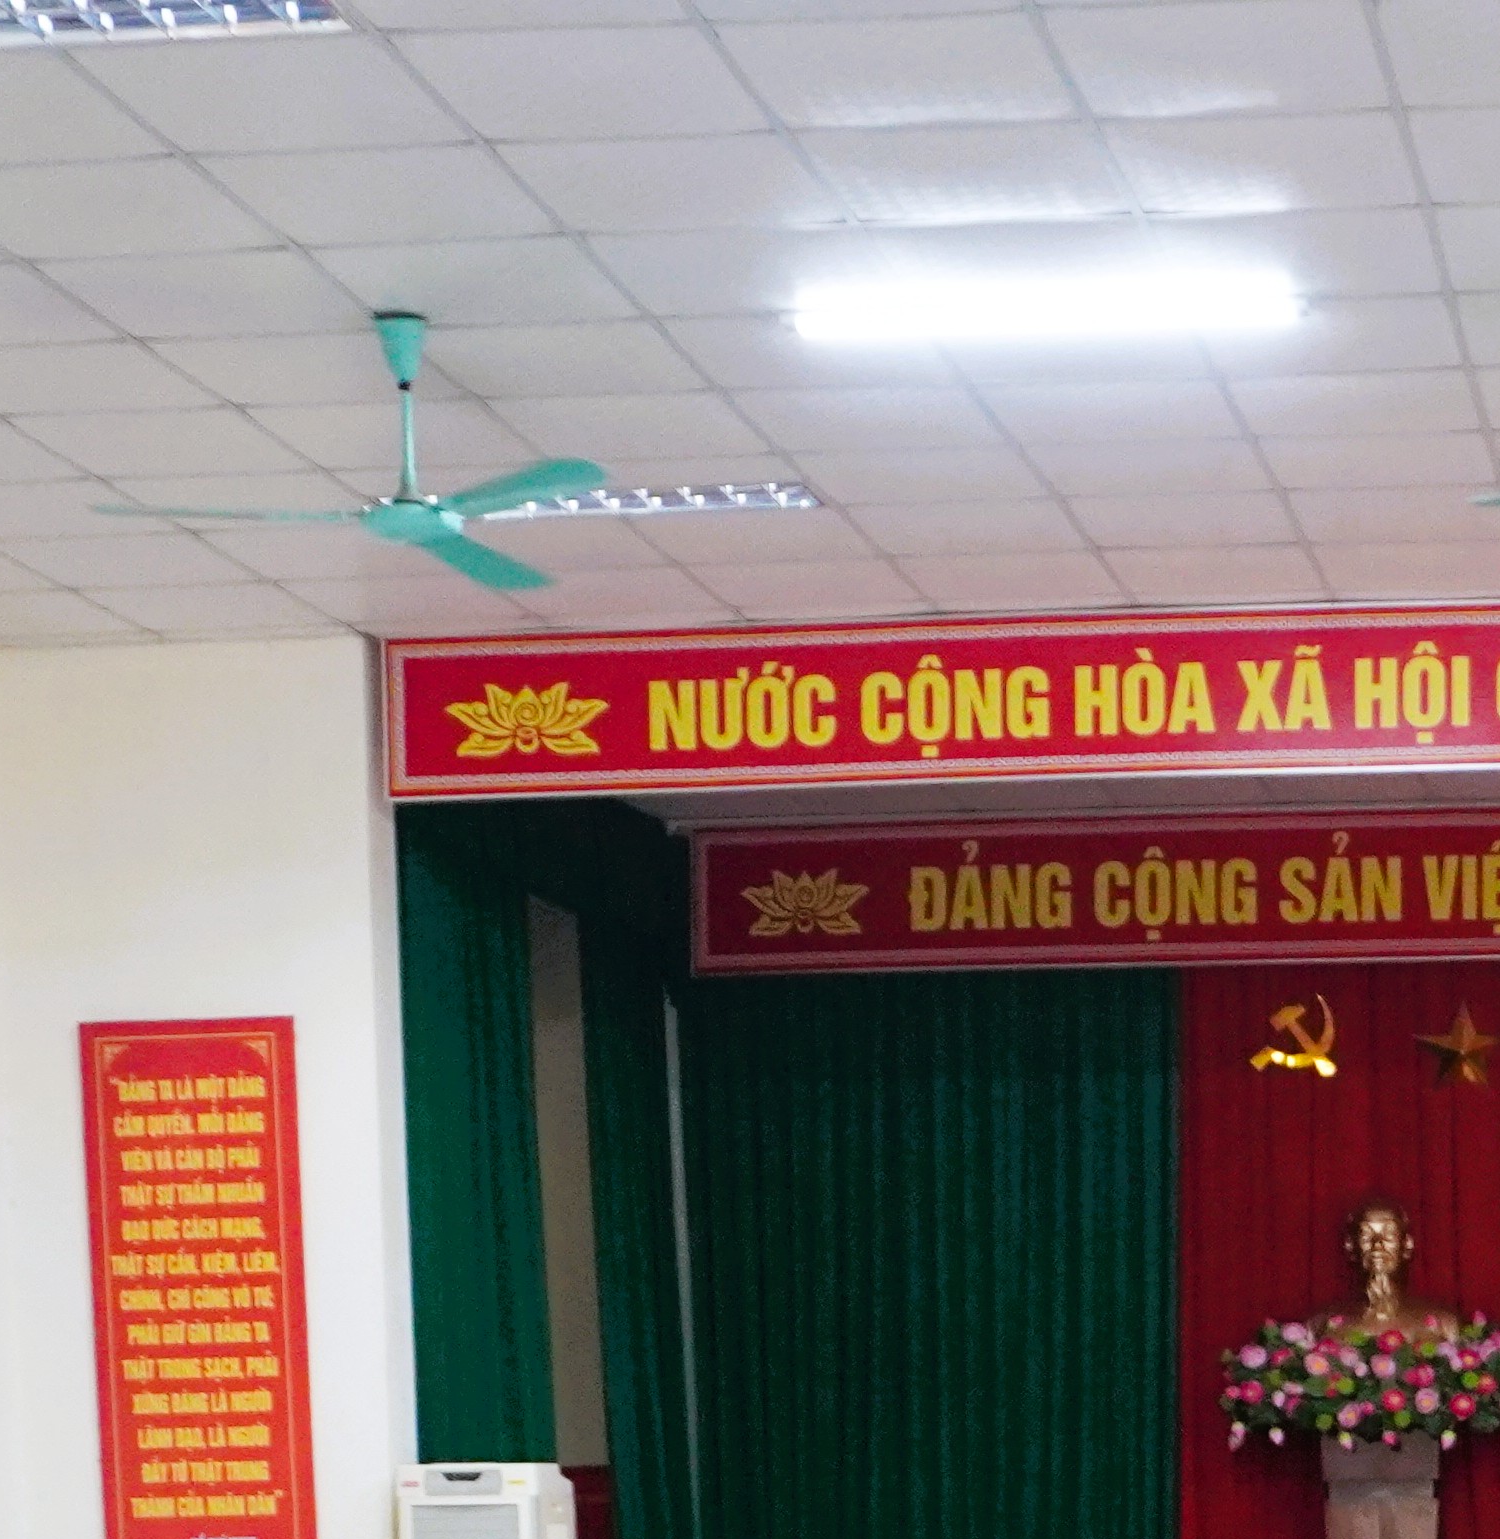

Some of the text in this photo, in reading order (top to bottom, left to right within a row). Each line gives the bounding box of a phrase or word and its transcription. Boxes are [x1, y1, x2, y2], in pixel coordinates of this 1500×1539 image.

[649, 661, 836, 750] NƯỚC
[861, 655, 1050, 757] CỘNG
[1075, 650, 1214, 735] HÒA
[1239, 646, 1329, 729] XÃ
[1355, 642, 1470, 742] HỘI
[907, 838, 1073, 933] ĐẢNG
[1091, 846, 1260, 940] CỘNG
[1277, 831, 1404, 925] SẢN
